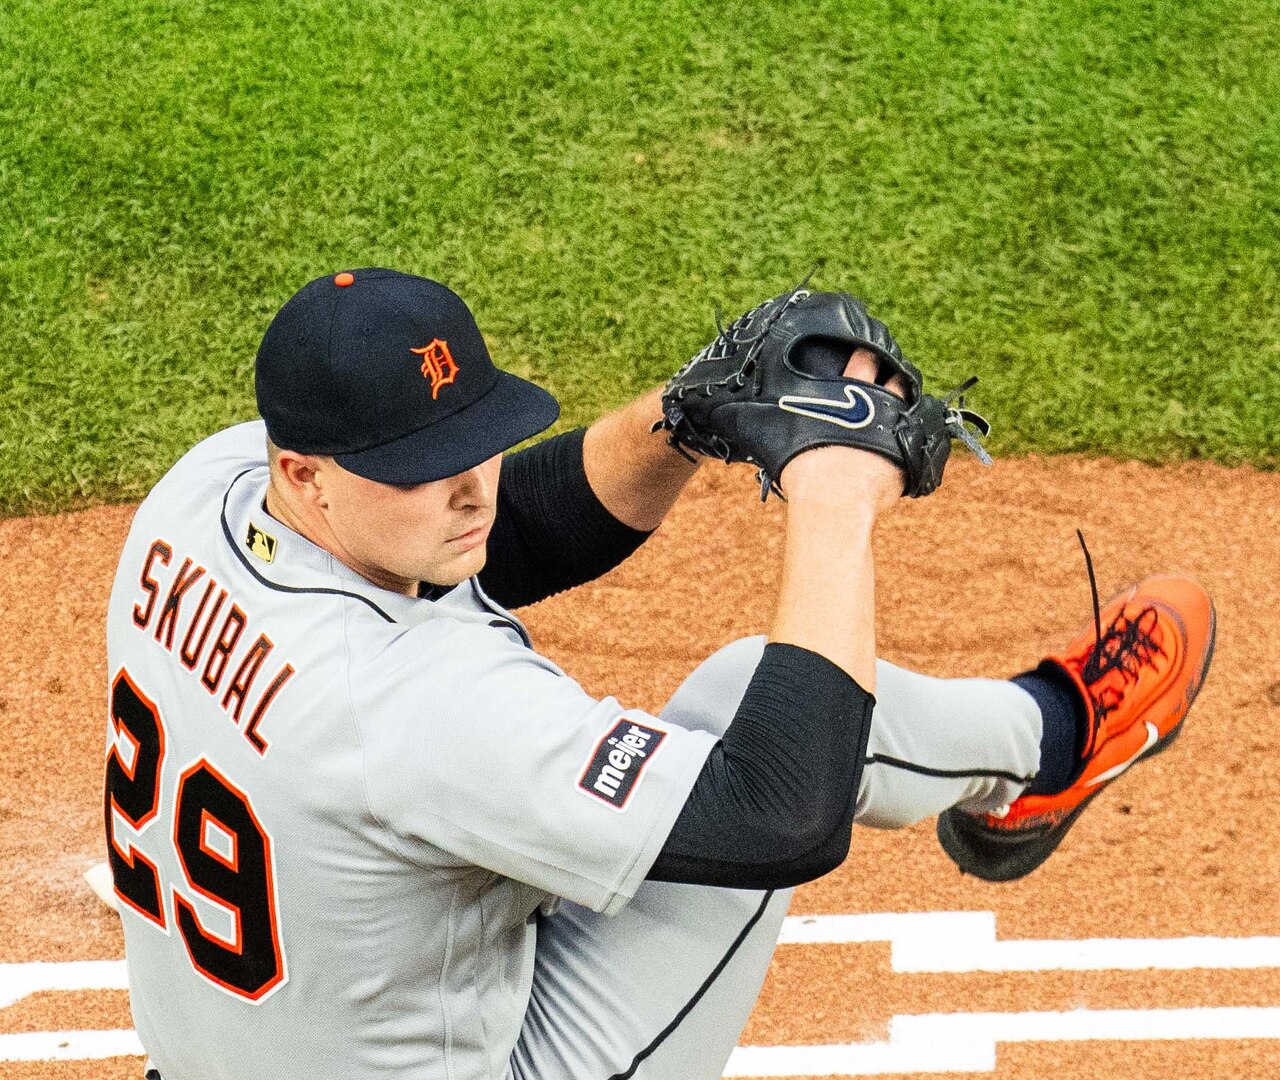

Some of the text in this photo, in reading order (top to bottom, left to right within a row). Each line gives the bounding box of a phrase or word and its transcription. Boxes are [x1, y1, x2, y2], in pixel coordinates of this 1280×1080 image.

[410, 338, 460, 400] D
[131, 538, 296, 757] SKUBAL
[103, 666, 287, 1002] 29
[593, 725, 652, 798] meijer
